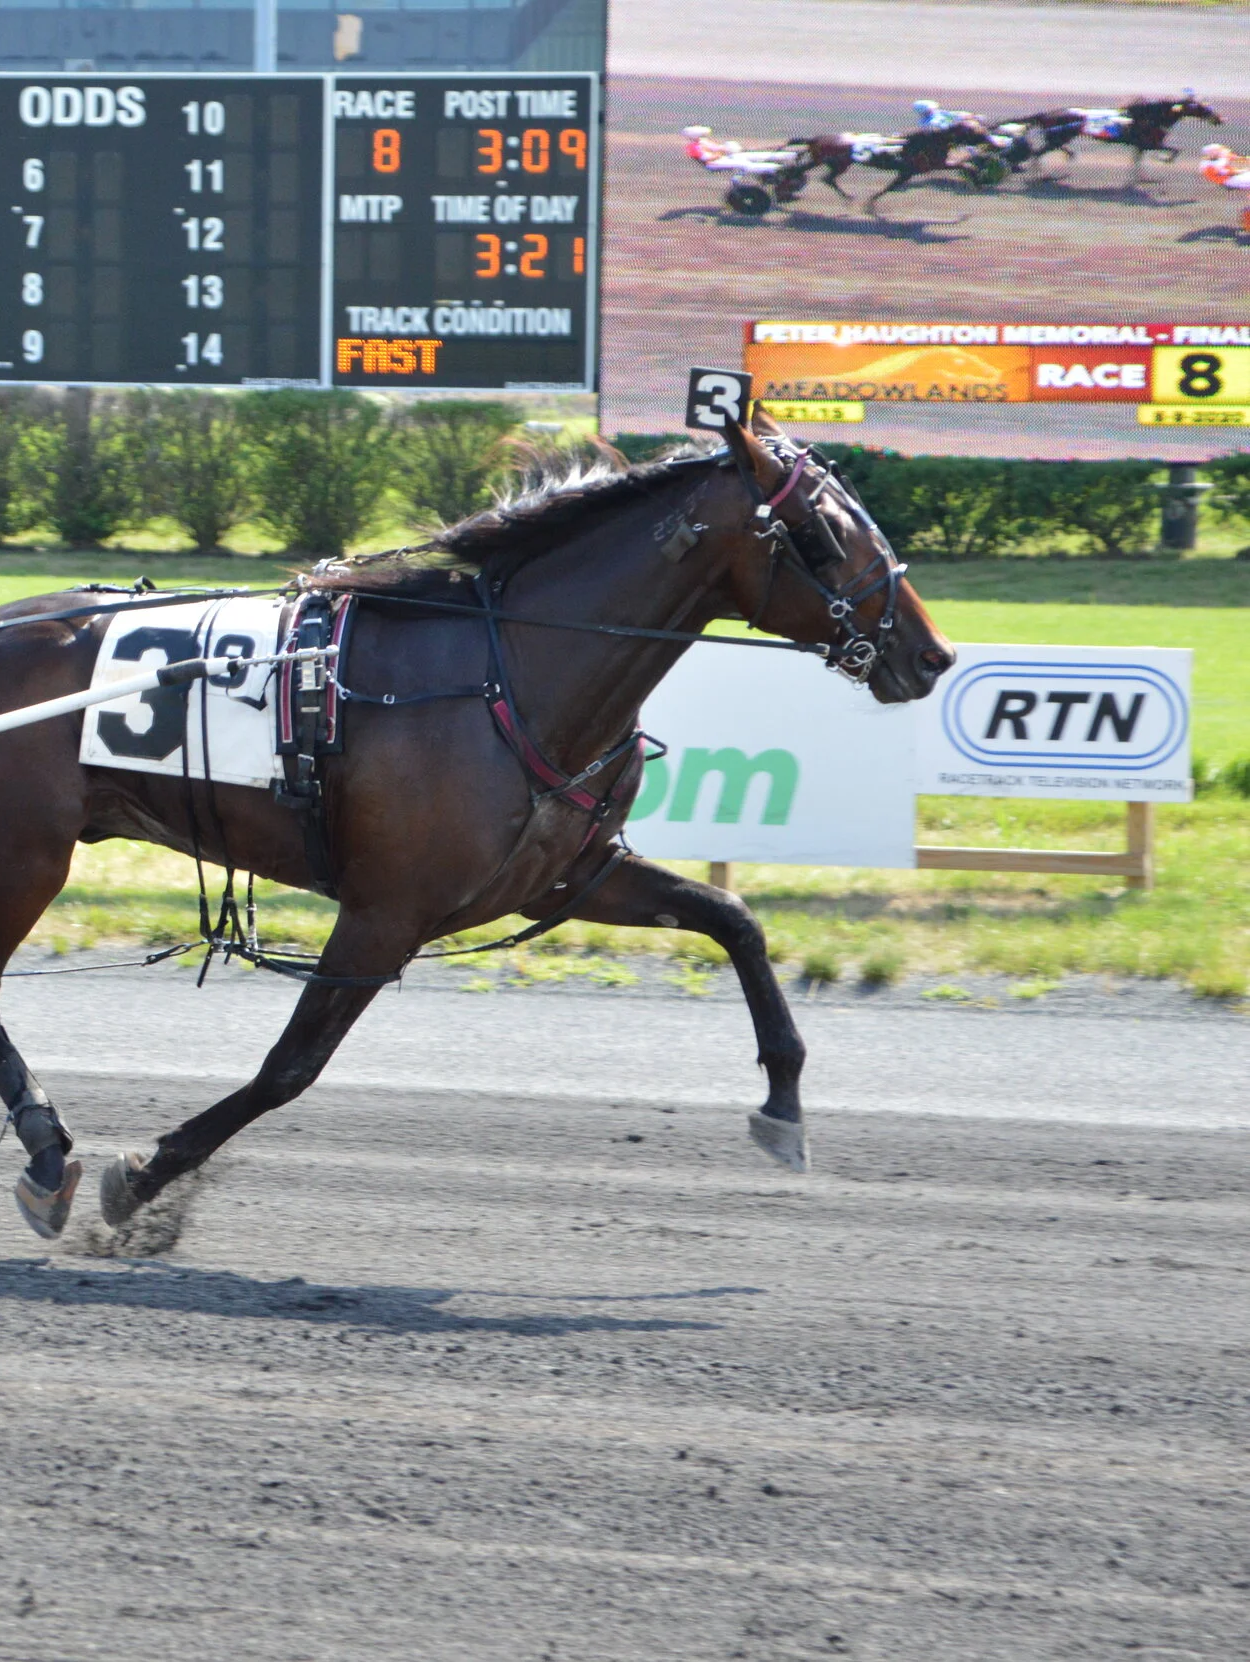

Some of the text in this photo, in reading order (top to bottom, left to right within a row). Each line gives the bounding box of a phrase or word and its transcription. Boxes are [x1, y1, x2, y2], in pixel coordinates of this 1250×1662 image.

[19, 86, 146, 128] ODDS
[182, 101, 225, 136] 10
[334, 90, 415, 119] RACE
[444, 90, 577, 119] POST TIME
[372, 128, 400, 173] 8
[477, 129, 587, 174] 3:09
[22, 158, 44, 192] 6
[185, 159, 224, 193] 11
[340, 194, 403, 223] MTP
[431, 195, 579, 224] TIME OF DAY
[23, 216, 45, 248] 7
[182, 217, 224, 251] 12
[476, 233, 585, 278] 3:21
[22, 272, 43, 305] 8
[182, 275, 224, 308] 13
[346, 307, 571, 336] TRACK CONDITION
[754, 324, 837, 343] PETER
[842, 325, 998, 344] HAUGHTON
[1002, 325, 1153, 345] MEMORIAL
[22, 329, 43, 363] 9
[182, 333, 223, 366] 14
[336, 338, 443, 375] FAST
[765, 381, 1008, 401] MEADOWLANDS
[1037, 364, 1146, 388] RACE
[1179, 353, 1222, 397] 8
[694, 374, 741, 427] 3
[97, 627, 203, 761] 3
[984, 690, 1147, 743] RTN
[937, 772, 1184, 791] RACETRACK TELEVISION NETWORK
